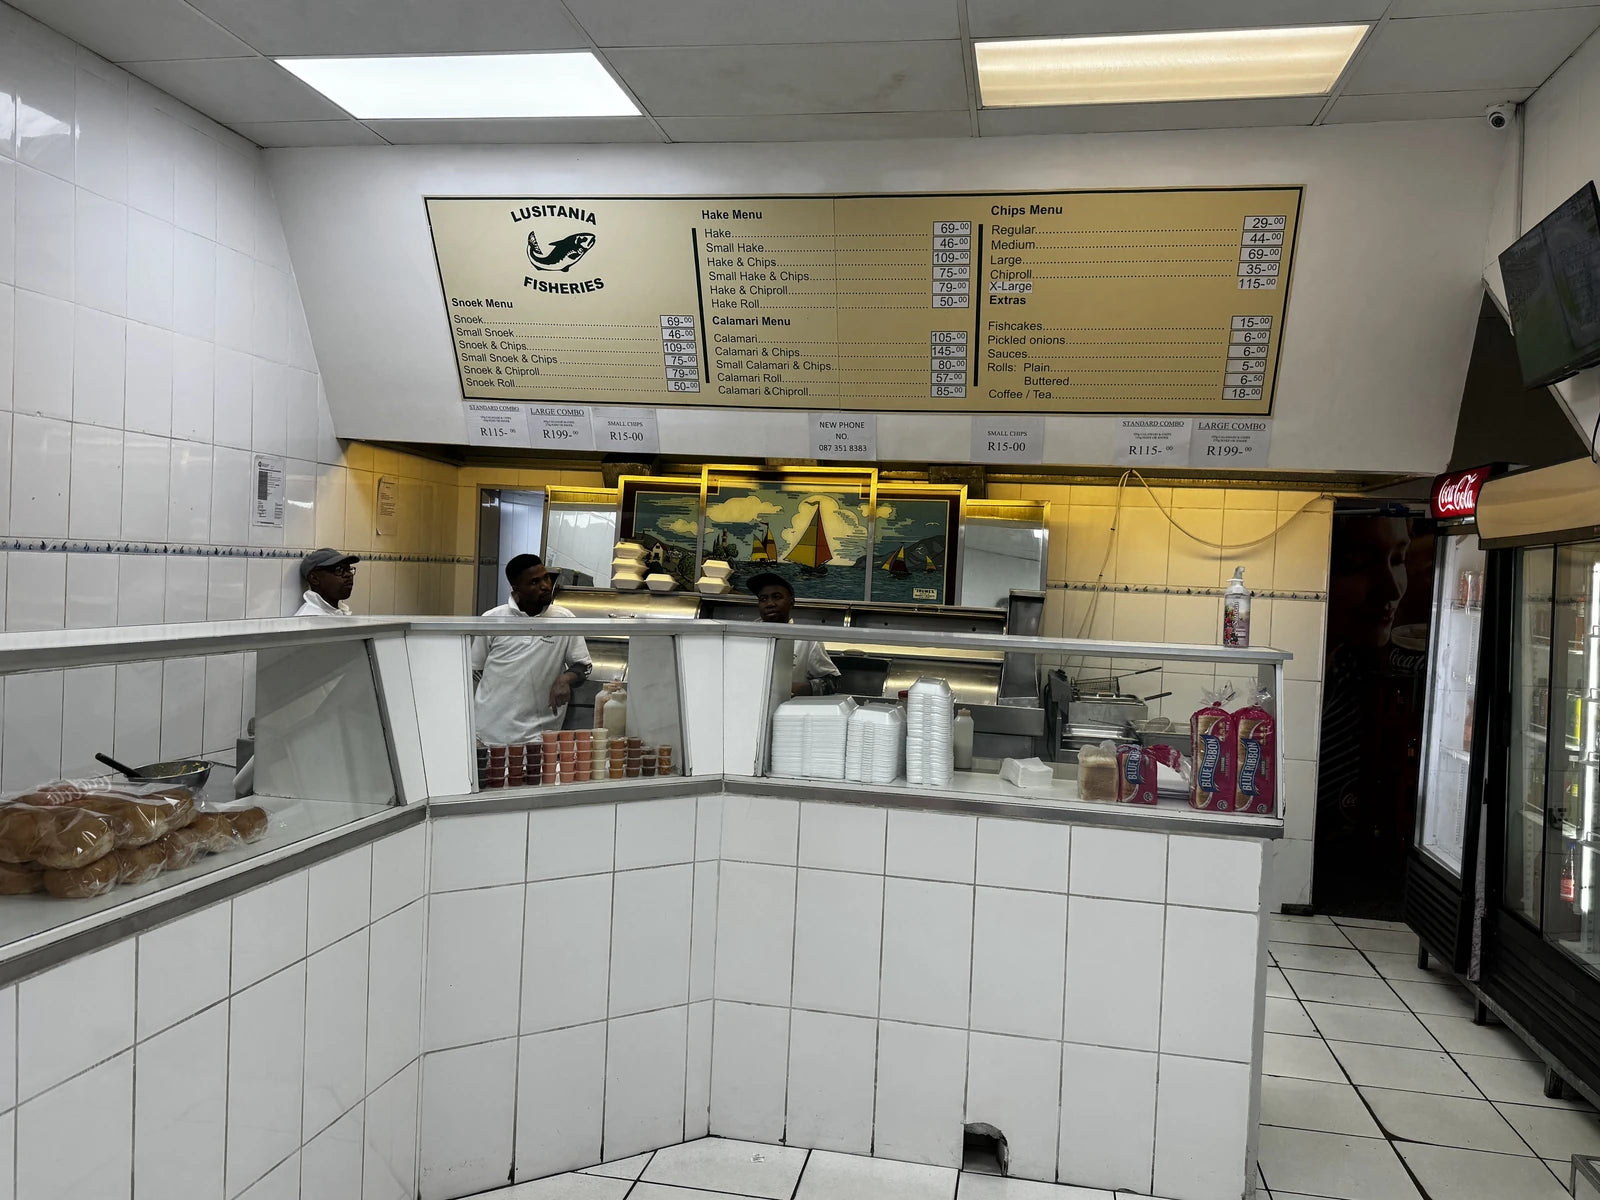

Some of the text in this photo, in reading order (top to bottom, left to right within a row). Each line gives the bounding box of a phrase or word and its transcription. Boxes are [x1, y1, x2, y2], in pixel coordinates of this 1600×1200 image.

[510, 205, 597, 225] LUSITANIA
[702, 210, 762, 219] Hake Menu
[991, 205, 1063, 216] Chips Menu
[704, 229, 731, 238] Hake
[991, 225, 1036, 236] Regular
[706, 243, 734, 252] Small
[738, 243, 764, 253] Hake
[991, 240, 1035, 250] Medium
[707, 258, 733, 267] Hake
[736, 258, 744, 267] &
[747, 258, 777, 269] Chips
[990, 255, 1022, 266] Large
[709, 271, 737, 281] Small
[740, 272, 767, 281] Hake
[770, 272, 777, 281] &
[780, 271, 809, 283] Chips
[990, 270, 1032, 281] Chiproll
[523, 276, 605, 294] FISHERIES
[990, 281, 1032, 293] X-Large
[710, 285, 736, 294] Hake
[739, 286, 747, 294] &
[750, 285, 788, 296] Chiproll
[452, 298, 513, 308] Snoek Menu
[712, 299, 738, 308] Hake
[741, 299, 760, 309] Roll
[990, 295, 1026, 305] Extras
[454, 315, 483, 324] Snoek
[712, 317, 791, 326] Calamari Menu
[988, 321, 1043, 331] Fishcakes
[457, 328, 482, 337] Small
[485, 329, 515, 338] Snoek
[714, 334, 758, 343] Calamari
[987, 335, 1026, 345] Pickled
[1029, 336, 1066, 345] onions
[459, 341, 488, 350] Snoek
[491, 341, 498, 350] &
[501, 341, 527, 352] Chips
[715, 347, 759, 356] Calamari
[762, 348, 769, 356] &
[772, 348, 800, 358] Chips
[988, 349, 1028, 359] Sauces
[461, 353, 486, 362] Small
[489, 353, 519, 363] Snoek
[521, 354, 529, 363] &
[531, 354, 558, 365] Chips
[716, 360, 743, 370] Small
[746, 360, 790, 370] Calamari
[793, 361, 800, 370] &
[803, 361, 832, 372] Chips
[987, 363, 1017, 373] Rolls:
[1023, 363, 1050, 373] Plain
[464, 366, 493, 375] Snoek
[495, 367, 503, 375] &
[505, 367, 540, 377] Chiproll
[466, 378, 495, 387] Snoek
[498, 379, 515, 388] Roll
[717, 373, 760, 382] Calamari
[764, 374, 783, 383] Roll
[1024, 376, 1070, 386] Buttered
[718, 386, 761, 395] Calamari
[989, 390, 1024, 400] Coffee
[1033, 390, 1052, 400] Tea
[530, 408, 585, 416] LARGE COMBO
[819, 421, 865, 429] NEW PHONE
[1198, 422, 1266, 431] LARGE COMBO
[610, 432, 643, 441] R15-00
[835, 432, 849, 440] NO.
[818, 444, 867, 452] 087 351 8383
[987, 441, 1025, 452] R15-00
[1201, 738, 1219, 787] BLUE RIBBON
[1242, 742, 1259, 791] BLUE RIBBON
[1127, 760, 1138, 780] BLUE
